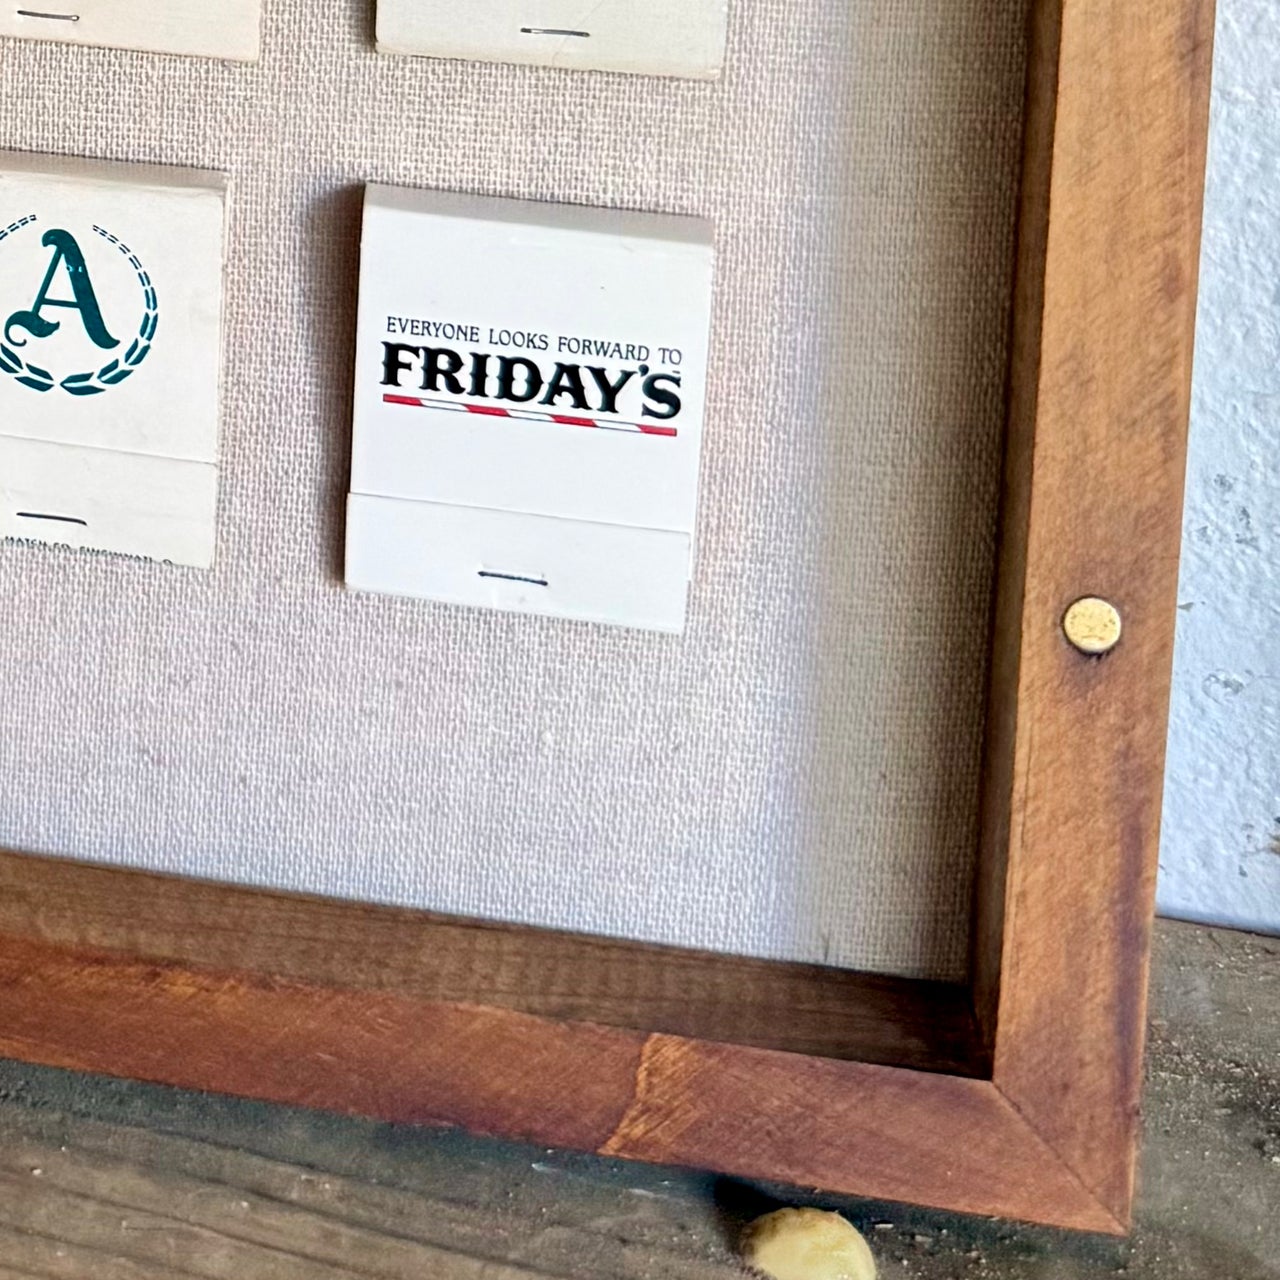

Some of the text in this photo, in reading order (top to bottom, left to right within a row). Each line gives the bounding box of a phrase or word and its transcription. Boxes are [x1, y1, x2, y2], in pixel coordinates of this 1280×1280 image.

[4, 229, 120, 349] A
[386, 316, 682, 365] EVERYONE LOOKS FORWARD TO
[379, 341, 681, 420] FRIDAY'S
